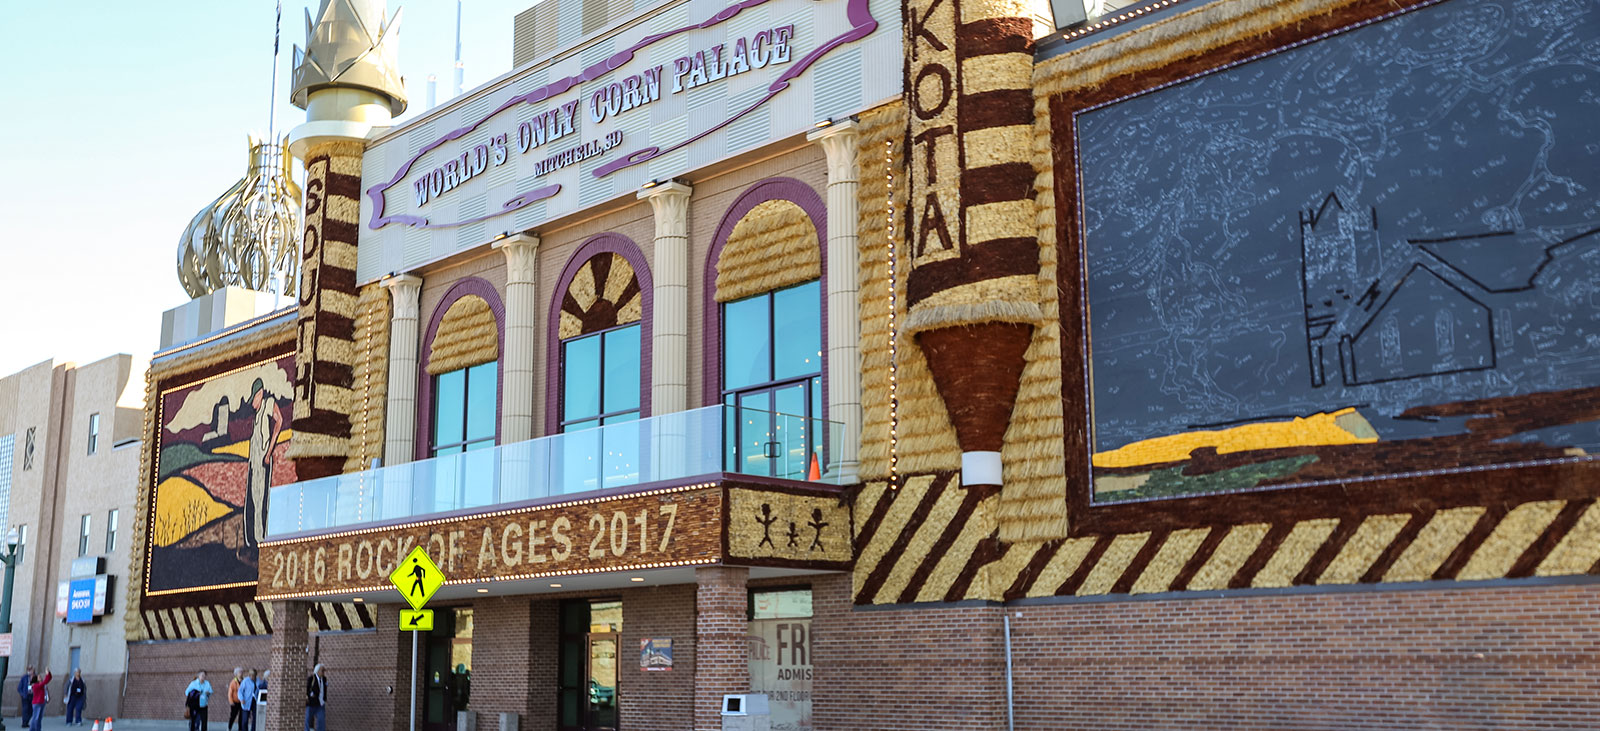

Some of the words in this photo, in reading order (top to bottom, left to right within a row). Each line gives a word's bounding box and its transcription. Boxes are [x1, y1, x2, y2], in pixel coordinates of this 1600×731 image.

[413, 132, 509, 208] WORLD'S
[516, 100, 579, 155] ONLY
[590, 65, 663, 125] CORN
[672, 24, 795, 95] PALACE
[293, 178, 323, 403] SOUTH
[273, 550, 327, 589] 2016
[337, 534, 416, 580] ROCK
[425, 530, 465, 573] OF
[478, 516, 572, 571] AGES
[588, 504, 678, 560] 2017
[777, 668, 812, 681] ADMIS
